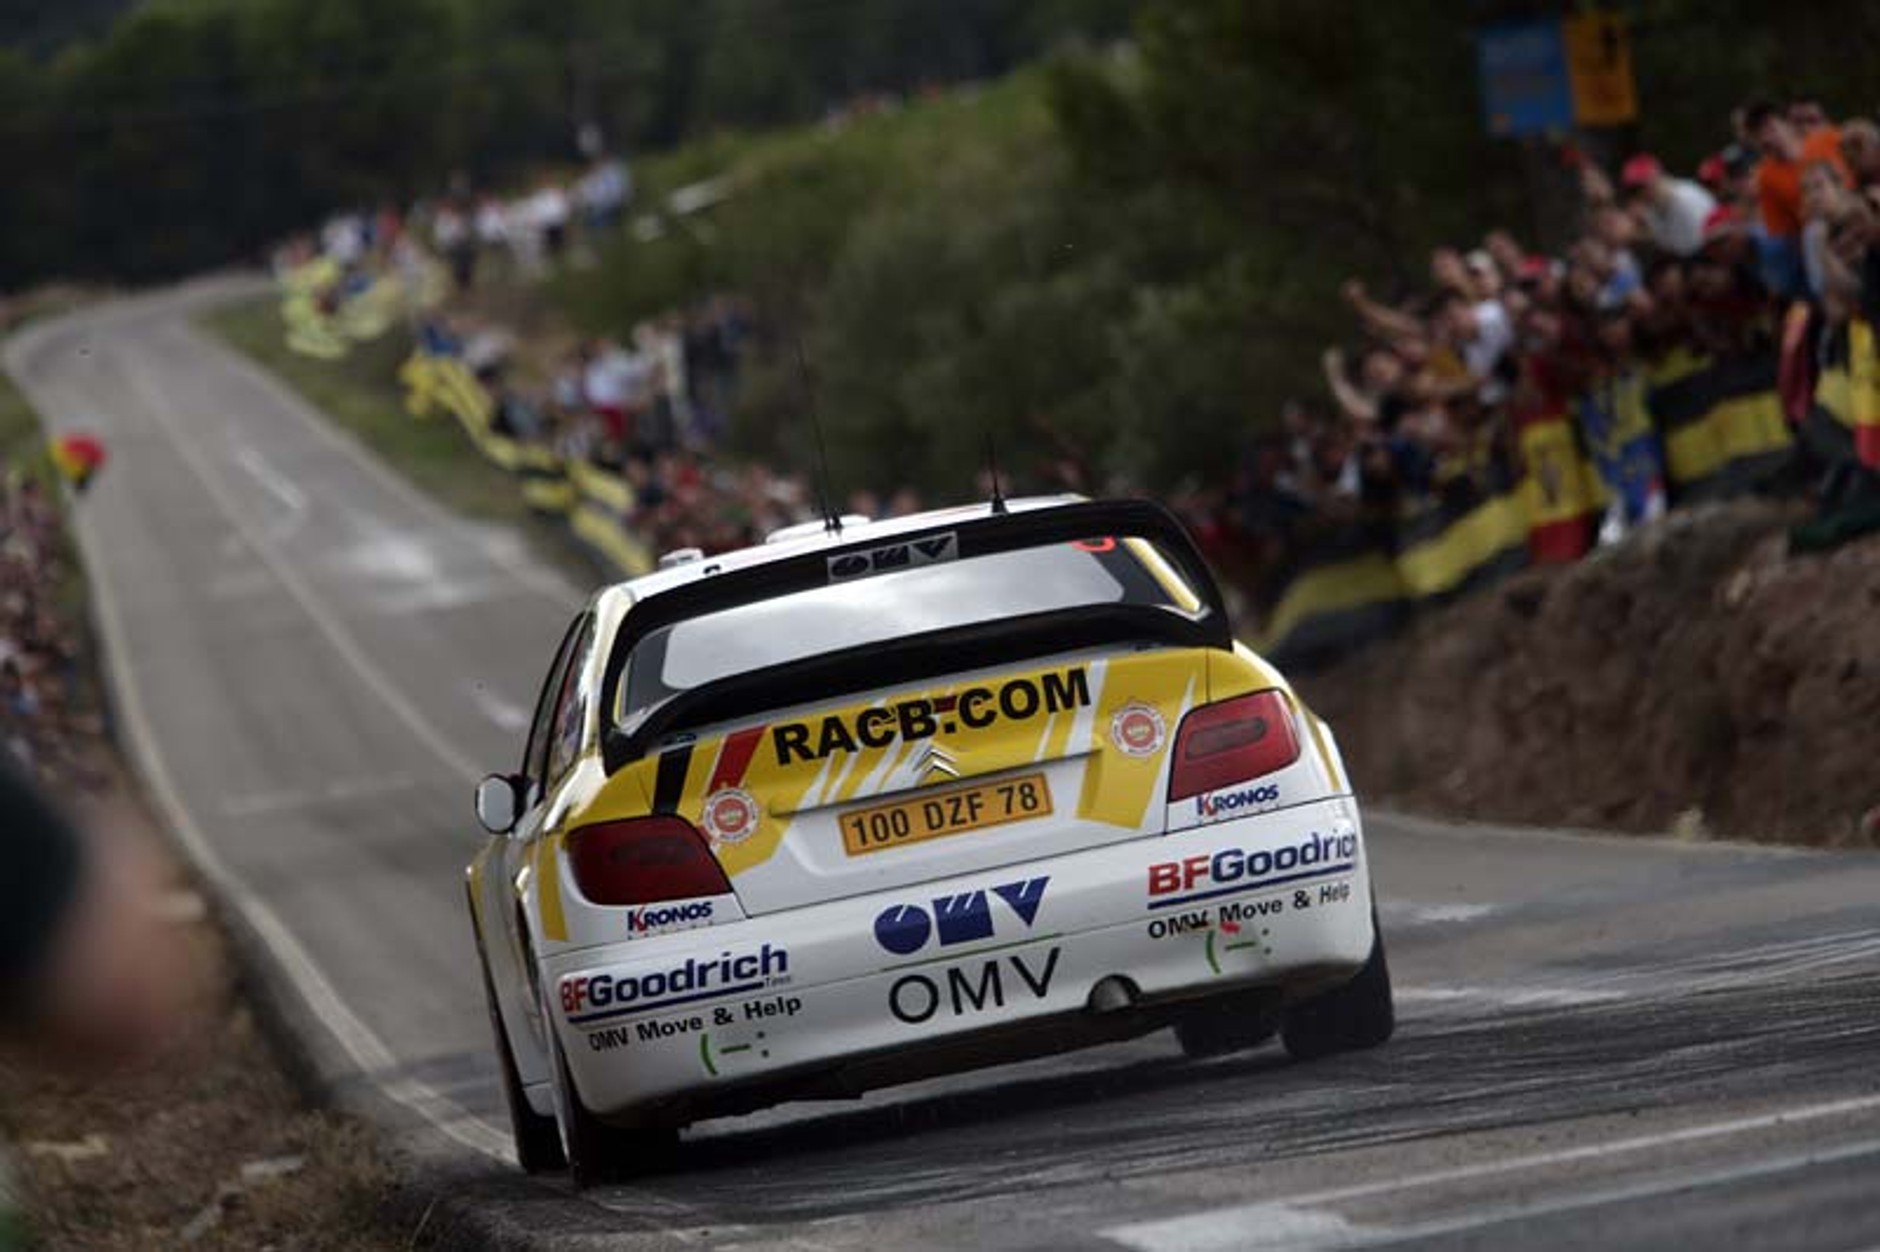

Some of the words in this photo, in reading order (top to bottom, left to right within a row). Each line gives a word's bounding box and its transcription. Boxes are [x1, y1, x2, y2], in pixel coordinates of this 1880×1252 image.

[832, 535, 954, 577] OMV
[773, 667, 1091, 765] RACB.COM
[852, 809, 910, 846] 100
[924, 793, 984, 831] DZF
[996, 782, 1039, 815] 78
[1196, 784, 1280, 817] KRONOS
[627, 902, 713, 932] KRONOS
[874, 876, 1051, 955] OMV
[1219, 897, 1283, 926] Move
[1293, 890, 1310, 910] &
[559, 944, 788, 1013] BFGoodrich
[888, 946, 1061, 1024] OMV
[589, 1027, 629, 1052] OMV
[636, 1015, 703, 1042] Move
[714, 1007, 734, 1026] &
[744, 996, 802, 1021] Help
